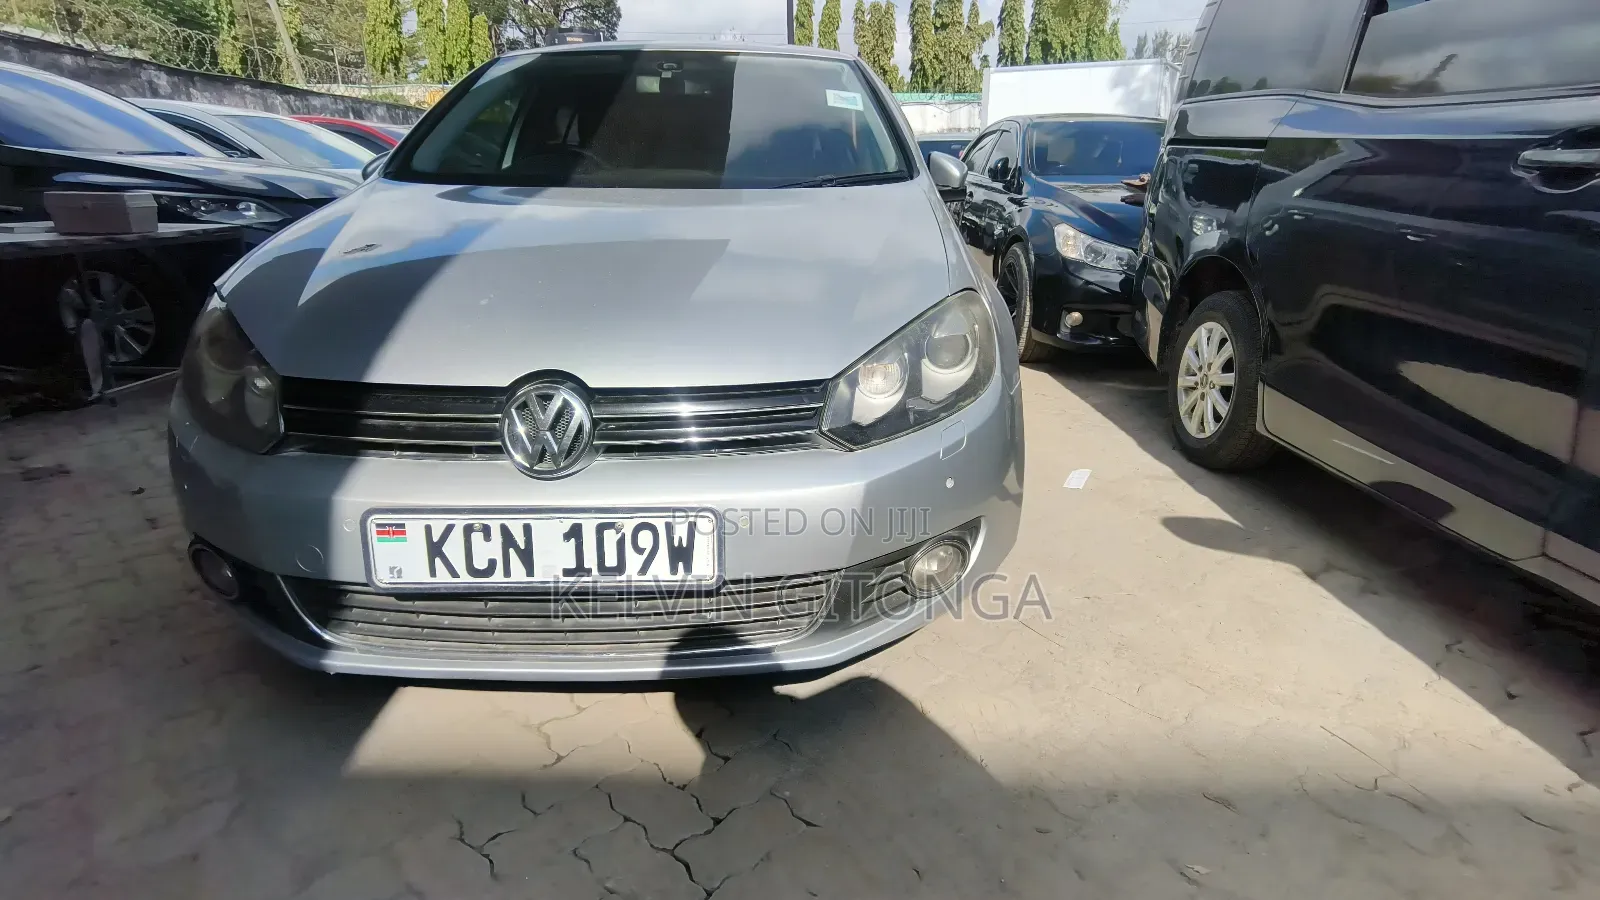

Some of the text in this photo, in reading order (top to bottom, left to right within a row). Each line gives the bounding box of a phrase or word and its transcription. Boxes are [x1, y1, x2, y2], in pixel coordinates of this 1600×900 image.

[503, 384, 592, 477] VW
[424, 522, 535, 578] KCN
[561, 520, 697, 577] 109W
